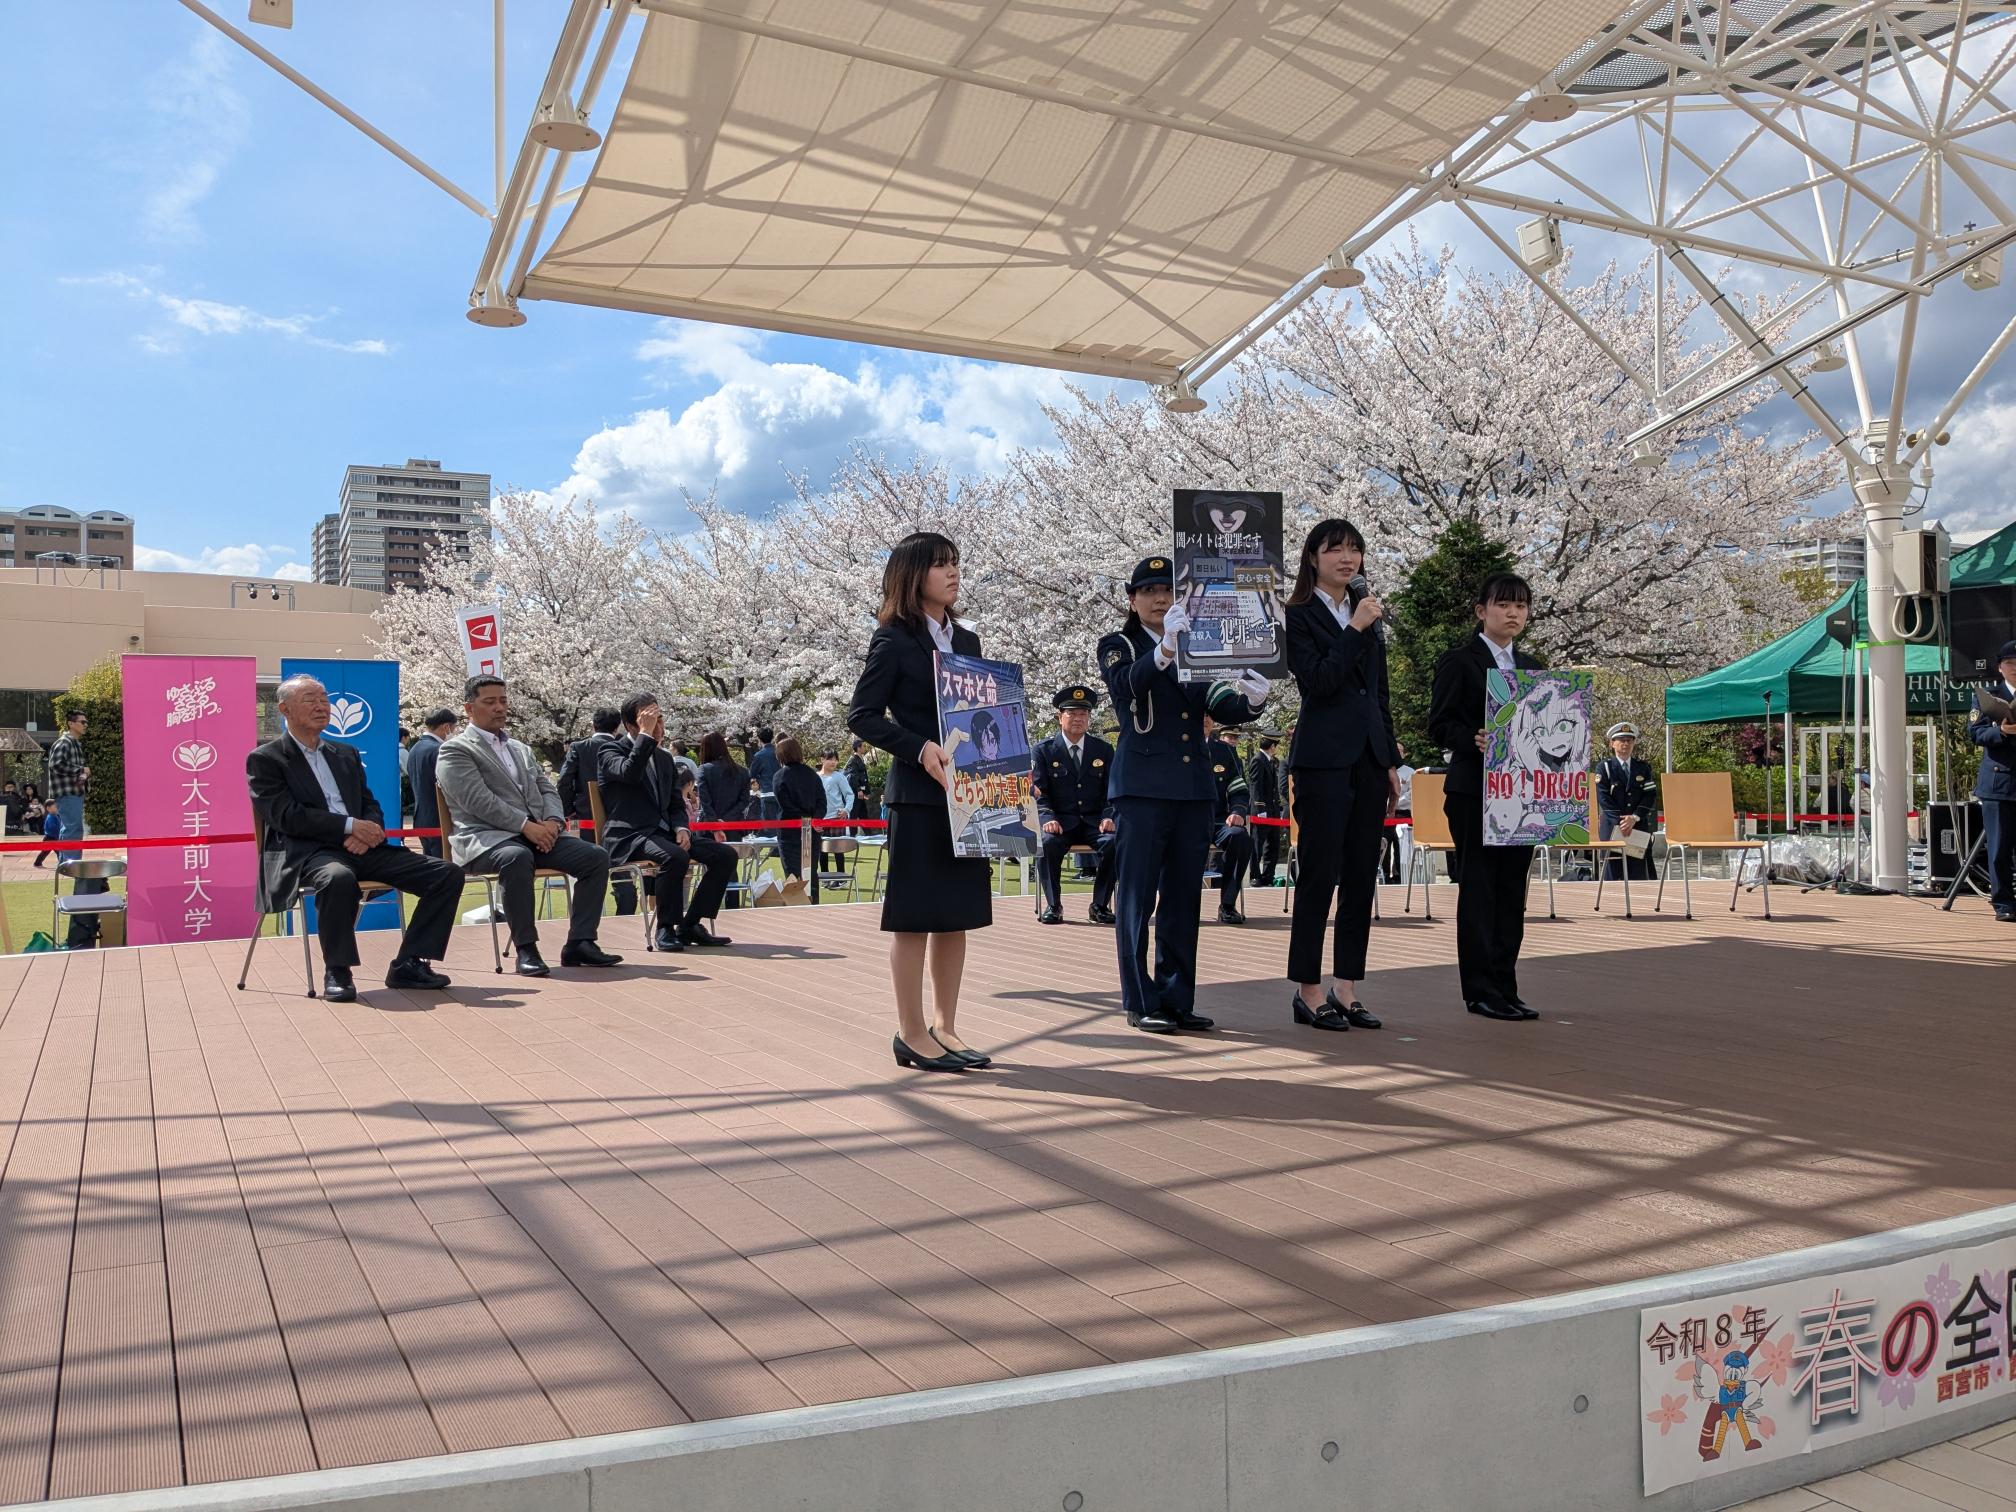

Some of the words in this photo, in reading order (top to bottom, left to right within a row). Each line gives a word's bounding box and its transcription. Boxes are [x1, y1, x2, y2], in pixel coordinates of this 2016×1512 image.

[1176, 531, 1261, 549] 闇バイトは犯罪です
[1219, 616, 1280, 645] 犯罪です
[942, 671, 997, 707] スマホと命
[1910, 692, 1977, 703] ARDE
[1487, 771, 1513, 800] NO
[181, 778, 213, 936] 大手前大学
[1646, 1306, 1768, 1366] 令和8年
[1791, 1267, 2016, 1426] 春の全
